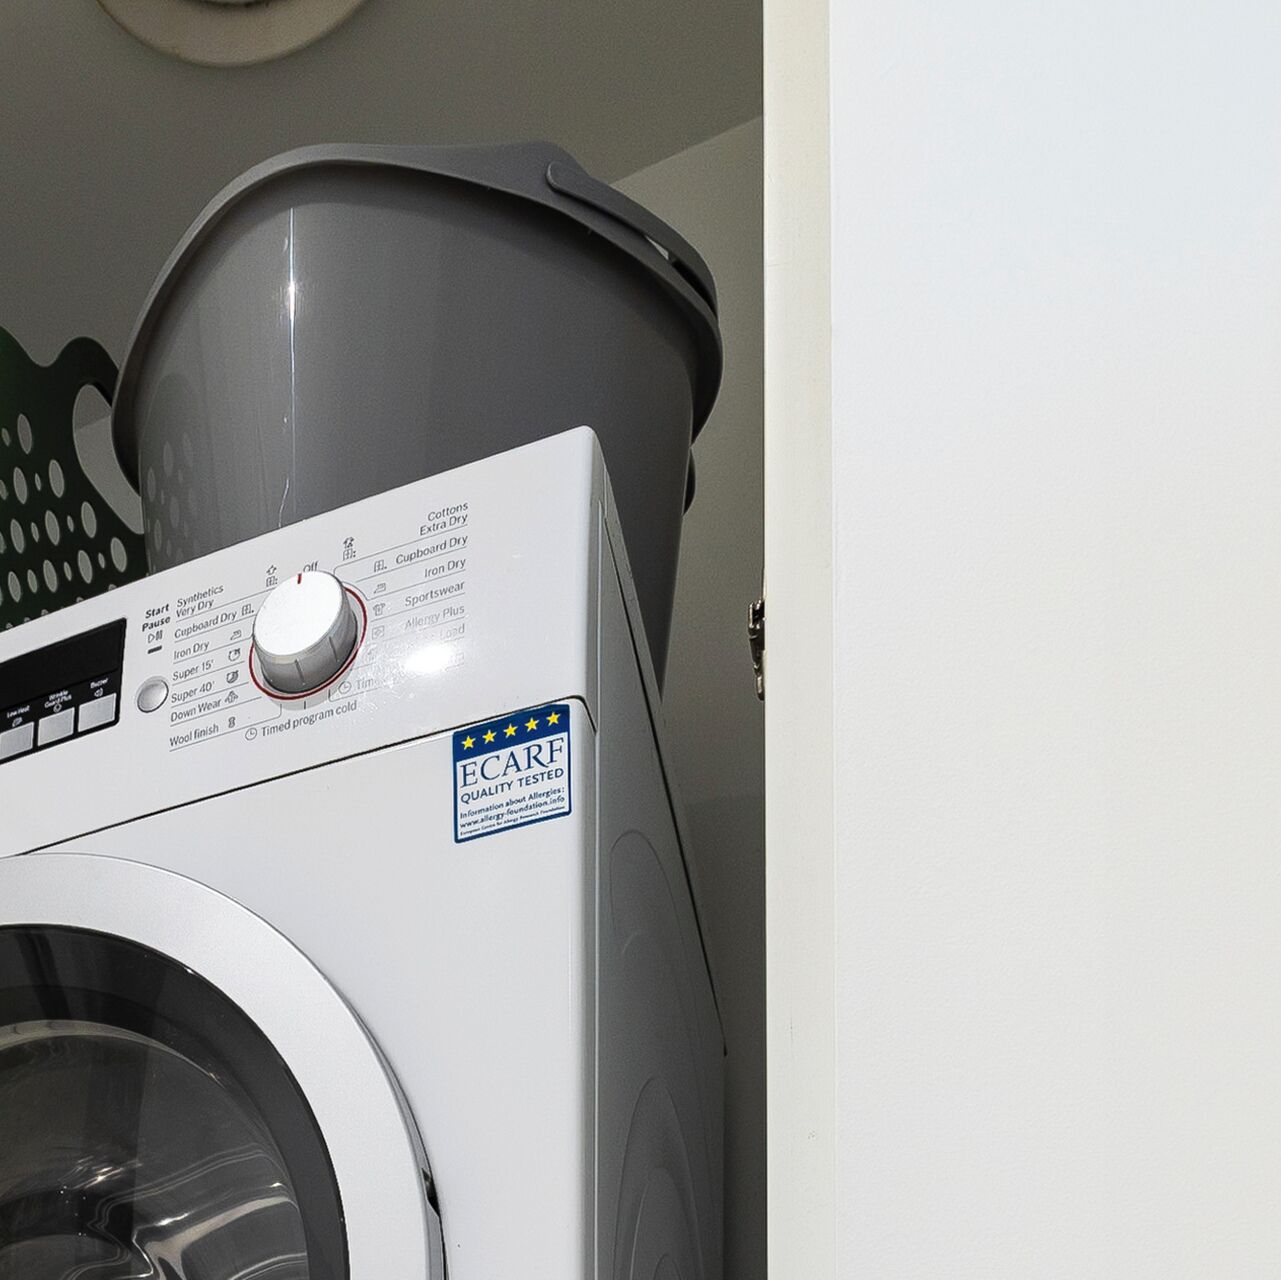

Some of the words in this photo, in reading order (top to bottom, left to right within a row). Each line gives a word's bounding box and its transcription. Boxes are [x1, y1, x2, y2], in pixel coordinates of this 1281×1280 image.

[427, 502, 469, 521] Cottons
[420, 519, 447, 536] Extra
[449, 513, 468, 527] Dry
[396, 541, 447, 565] Cupboard
[449, 535, 468, 548] Dry
[424, 564, 445, 578] Iron
[447, 558, 466, 571] Dry
[176, 584, 224, 608] Synthetics
[405, 580, 465, 607] Sportswear
[145, 603, 170, 619] Start
[175, 604, 197, 619] Very
[197, 599, 214, 612] Dry
[405, 612, 441, 630] Allergy
[442, 605, 465, 619] Plus
[142, 616, 170, 632] Pause
[174, 615, 219, 640] Cupboard
[220, 609, 237, 623] Dry
[173, 645, 192, 660] Iron
[193, 641, 210, 655] Dry
[172, 664, 200, 681] Super
[171, 687, 199, 703] Super
[170, 705, 196, 723] Down
[197, 699, 222, 714] Wear
[261, 719, 291, 737] Timed
[292, 707, 334, 731] program
[335, 700, 357, 715] cold
[170, 731, 192, 747] Wool
[193, 724, 219, 740] finish
[460, 737, 565, 788] ECARF
[460, 781, 513, 804] QUALITY
[517, 768, 565, 788] TESTED
[460, 802, 504, 819] Information
[505, 796, 527, 807] about
